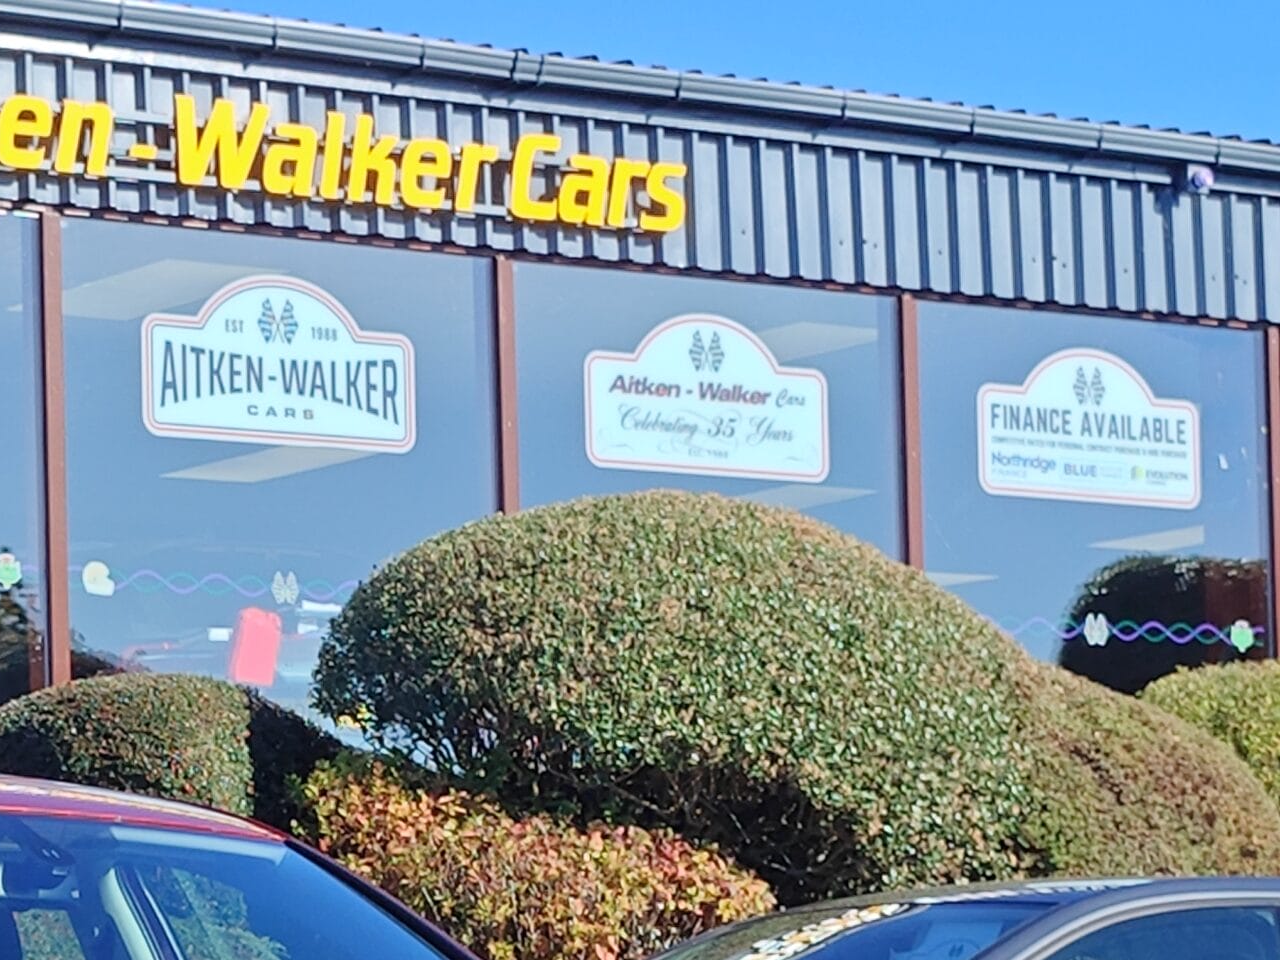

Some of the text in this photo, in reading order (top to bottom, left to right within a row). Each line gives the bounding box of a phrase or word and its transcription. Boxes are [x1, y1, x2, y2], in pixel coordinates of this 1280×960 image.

[173, 93, 498, 214] Walker
[509, 132, 687, 233] Cars
[225, 318, 244, 334] EST
[160, 340, 400, 426] AITKEN-WALKER
[608, 375, 681, 398] Aitken
[698, 381, 771, 405] Walker
[247, 404, 315, 420] CARS
[707, 416, 737, 438] 35
[990, 403, 1187, 445] FINANCE AVAILABLE
[991, 451, 1057, 474] Northridge
[1063, 463, 1098, 478] BLUE
